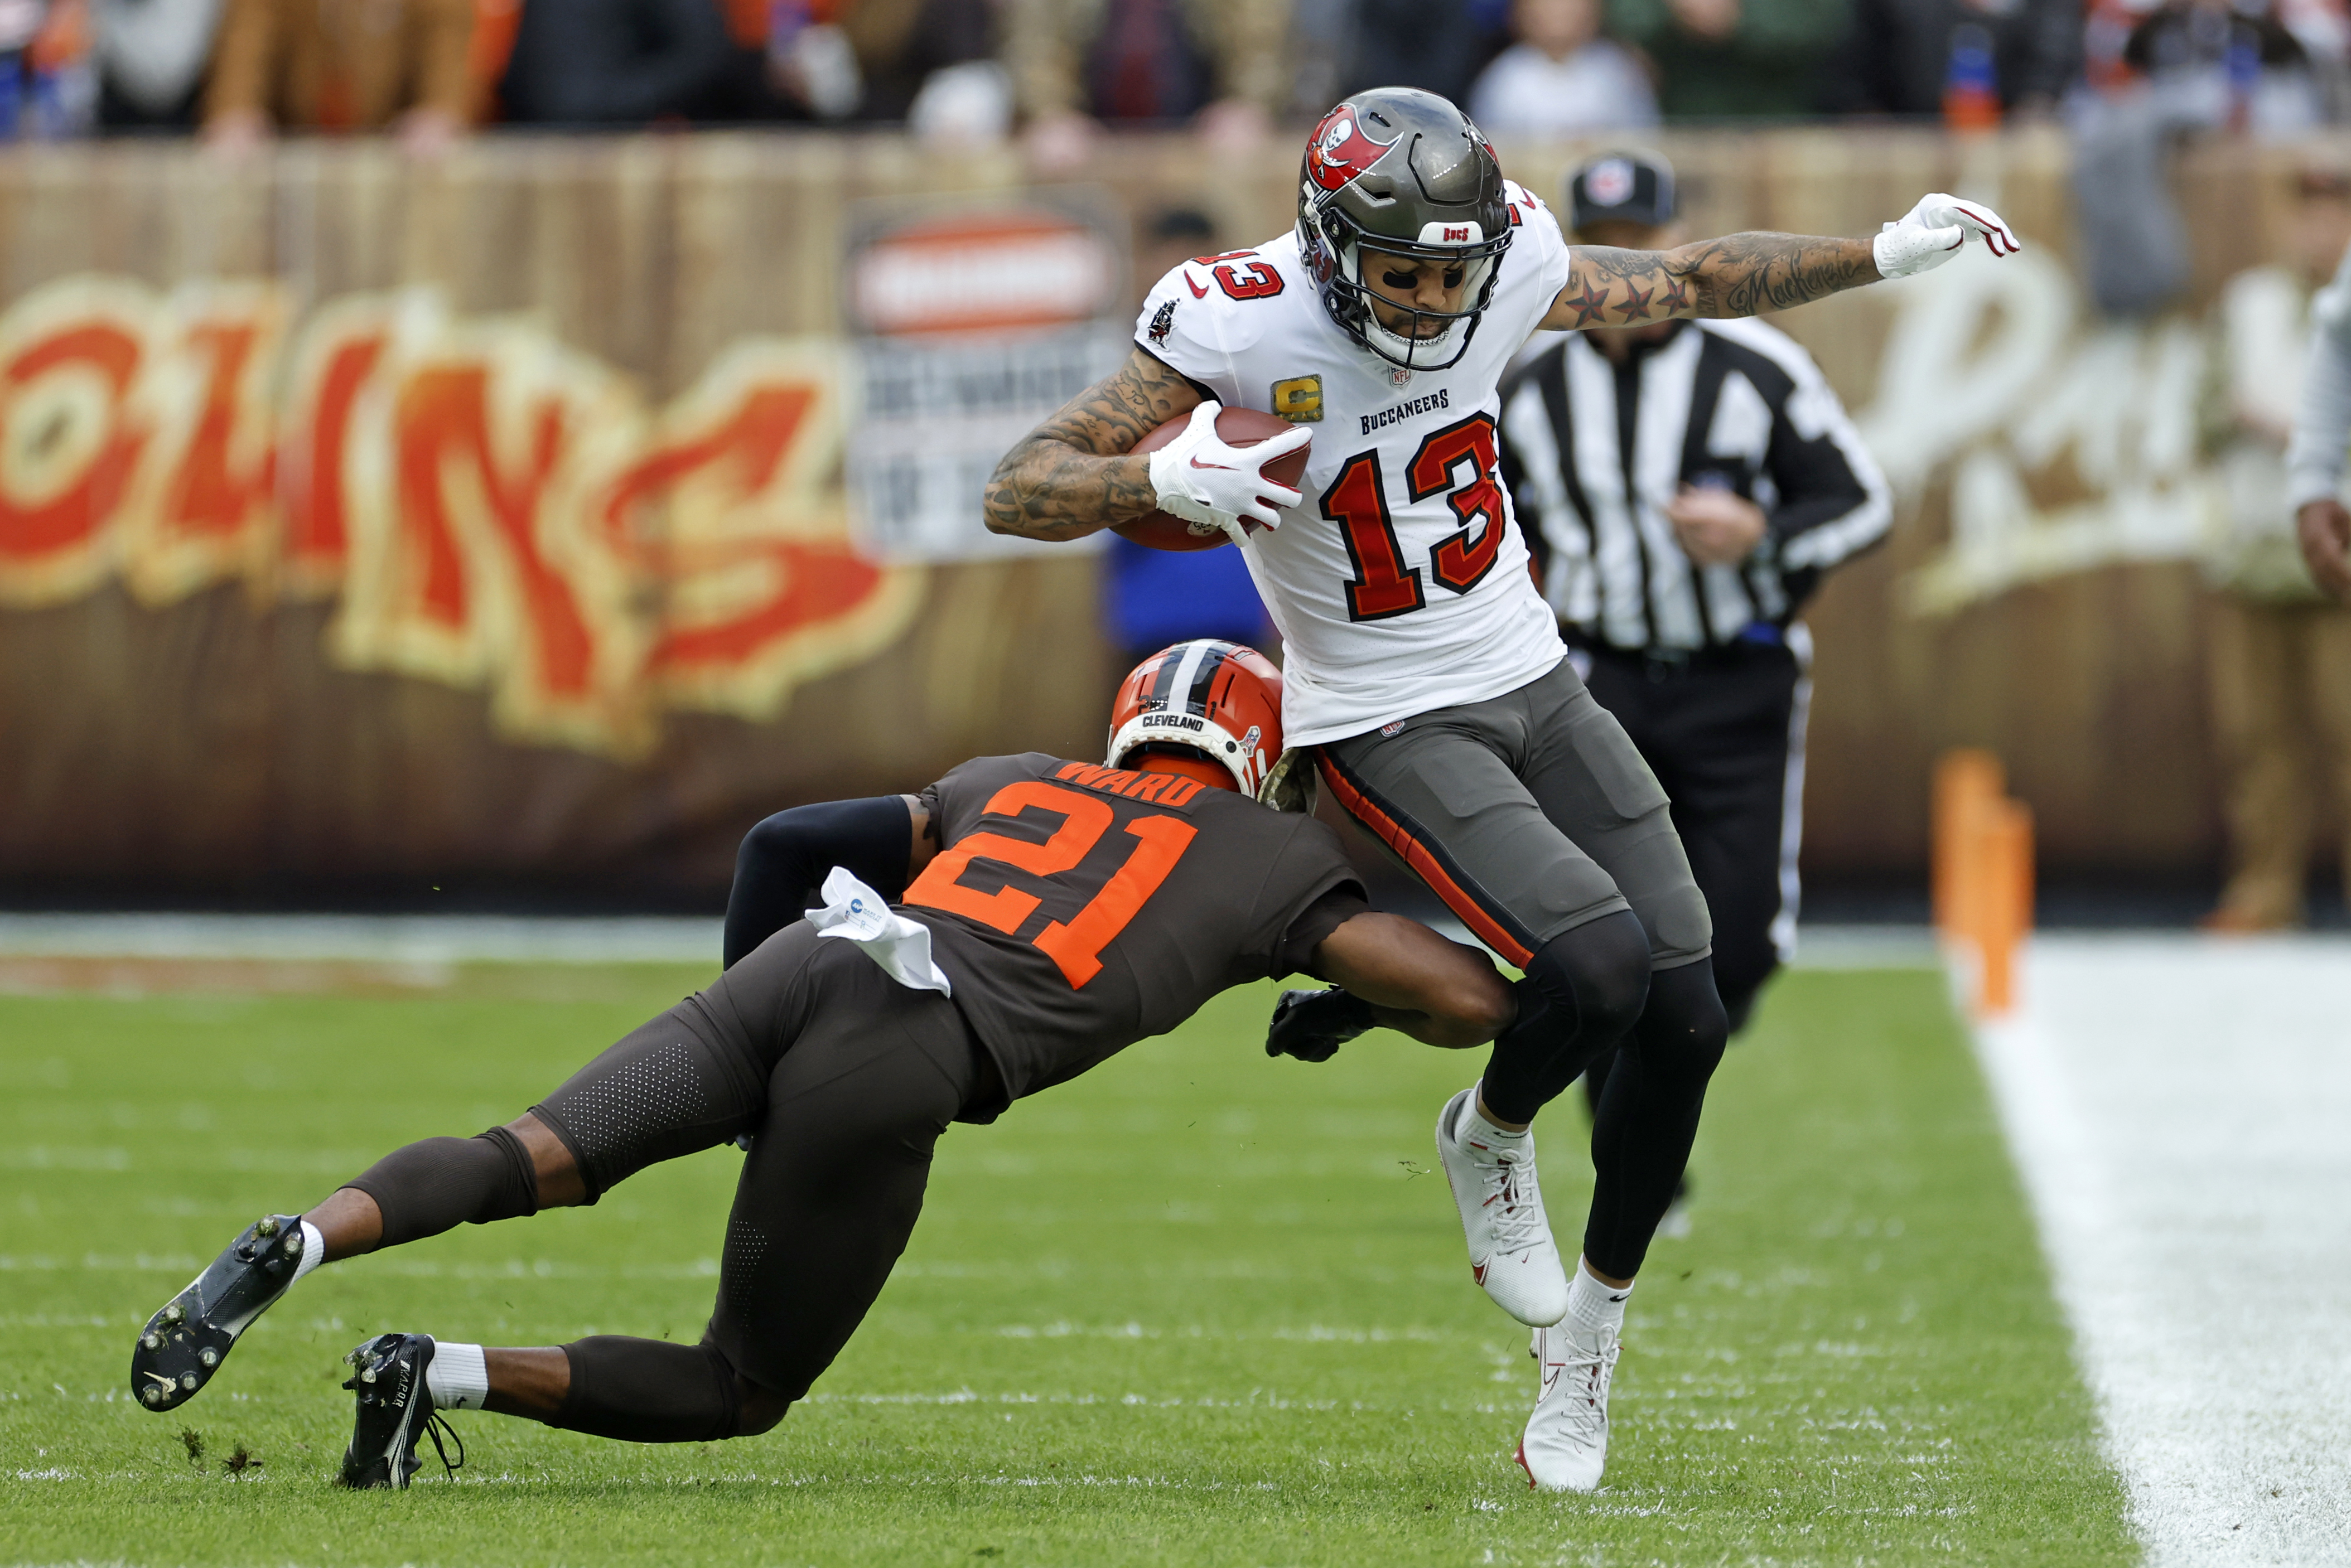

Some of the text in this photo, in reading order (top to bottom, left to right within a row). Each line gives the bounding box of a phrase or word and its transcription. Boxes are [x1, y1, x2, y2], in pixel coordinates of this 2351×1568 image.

[1190, 251, 1285, 301] 13
[1394, 369, 1409, 383] NFL
[1276, 379, 1319, 413] C
[1319, 410, 1506, 622] 13
[1143, 715, 1204, 732] CLEVELAND
[1055, 762, 1206, 807] WARD
[902, 781, 1198, 991] 21
[863, 908, 877, 916] MAKE
[395, 1368, 411, 1407] VAPOR
